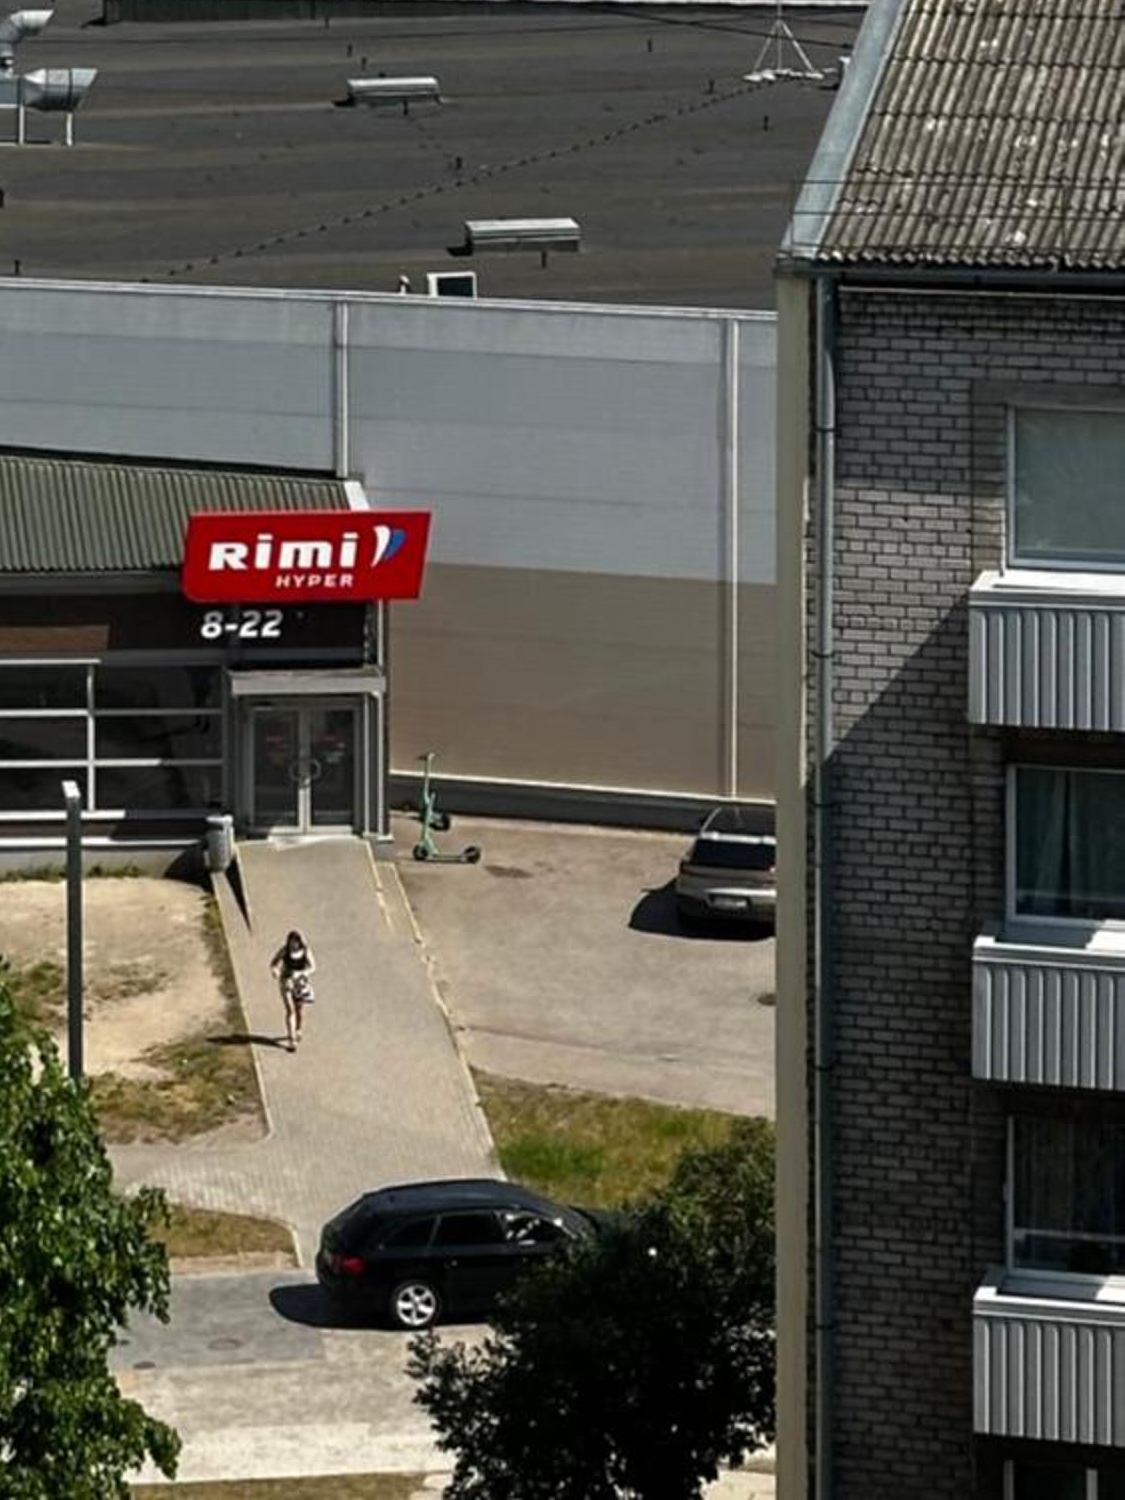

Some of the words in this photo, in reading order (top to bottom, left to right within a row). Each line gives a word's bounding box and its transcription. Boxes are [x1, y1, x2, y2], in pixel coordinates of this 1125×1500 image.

[208, 532, 358, 570] Rimi
[275, 574, 354, 588] HYPER
[201, 610, 283, 638] 8-22
